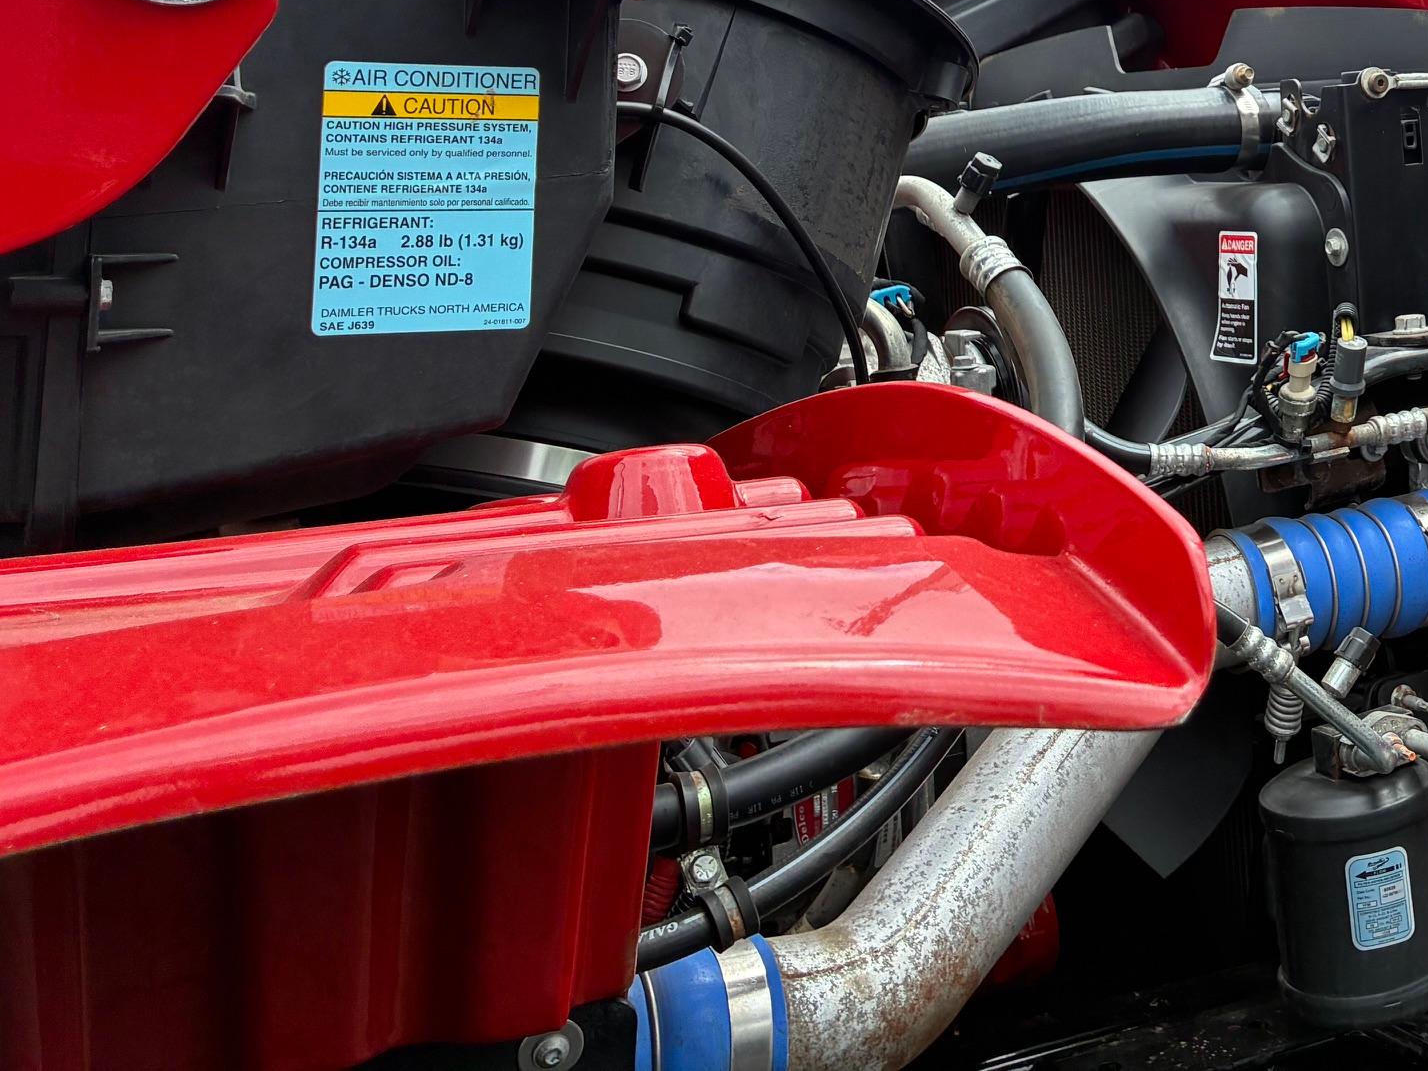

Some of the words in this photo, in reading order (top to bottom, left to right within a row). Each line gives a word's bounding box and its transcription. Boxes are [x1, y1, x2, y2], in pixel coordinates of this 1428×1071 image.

[352, 69, 387, 86] AIR
[394, 71, 536, 89] CONDITIONER
[404, 98, 495, 115] CAUTION
[326, 121, 380, 131] CAUTION
[384, 122, 413, 131] HIGH
[416, 122, 480, 131] PRESSURE
[483, 123, 531, 133] SYSTEM,
[326, 134, 387, 143] CONTAINS
[391, 135, 474, 144] REFRIGERANT
[478, 136, 502, 144] 134a
[366, 149, 407, 157] serviced
[410, 149, 429, 158] only
[431, 149, 442, 158] by
[445, 149, 484, 158] qualified
[486, 150, 532, 159] personnel.
[324, 170, 394, 180] PRECAUCIÓN
[397, 172, 443, 180] SISTEMA
[446, 172, 453, 180] A
[456, 172, 481, 180] ALTA
[484, 170, 530, 182] PRESIÓN,
[323, 185, 378, 193] CONTIENE
[381, 185, 462, 193] REFRIGERANTE
[465, 185, 487, 193] 134a
[446, 200, 459, 208] por
[461, 198, 493, 208] personal
[495, 198, 529, 206] calificado.
[322, 217, 434, 229] REFRIGERANT:
[321, 236, 377, 249] R-134a
[401, 235, 433, 248] 2.88
[439, 234, 453, 247] lb
[458, 234, 494, 250] (1.31
[501, 234, 523, 250] kg)
[1227, 240, 1254, 251] DANGER
[320, 256, 427, 269] COMPRESSOR
[433, 255, 461, 267] OIL:
[319, 276, 353, 289] PAG
[370, 274, 429, 287] DENSO
[435, 273, 473, 286] ND-8
[321, 308, 374, 317] DAIMLER
[377, 306, 425, 316] TRUCKS
[429, 304, 469, 315] NORTH
[473, 303, 524, 313] AMERICA
[320, 321, 345, 331] SAE
[348, 320, 375, 330] J639
